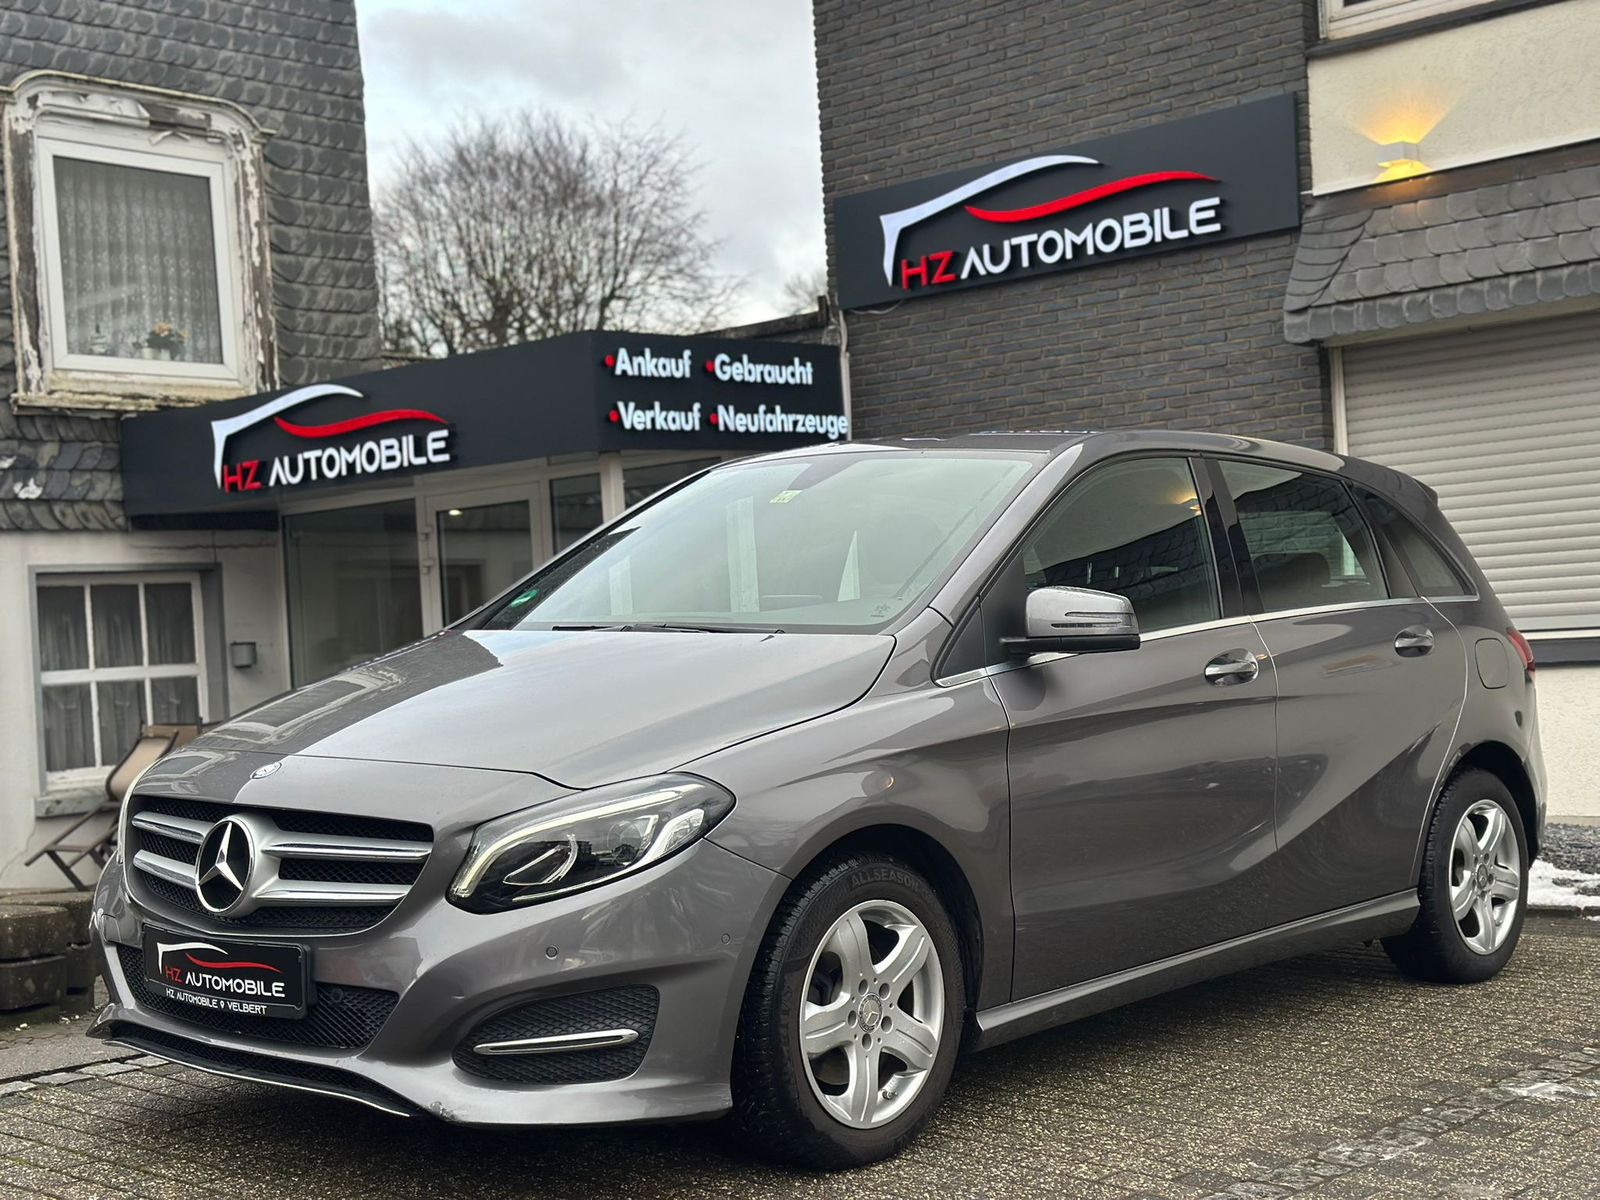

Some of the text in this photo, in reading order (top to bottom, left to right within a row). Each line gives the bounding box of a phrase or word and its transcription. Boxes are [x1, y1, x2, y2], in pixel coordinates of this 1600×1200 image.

[901, 196, 1222, 290] HZ AUTOMOBILE
[614, 347, 814, 386] Ankauf Gebraucht
[616, 401, 849, 440] Verkauf Neufahrzeuge
[223, 429, 450, 494] HZ AUTOMOBILE
[165, 965, 286, 998] HZ AUTOMOBILE
[166, 987, 267, 1015] HZ AUTOMOBILE VELBERT
